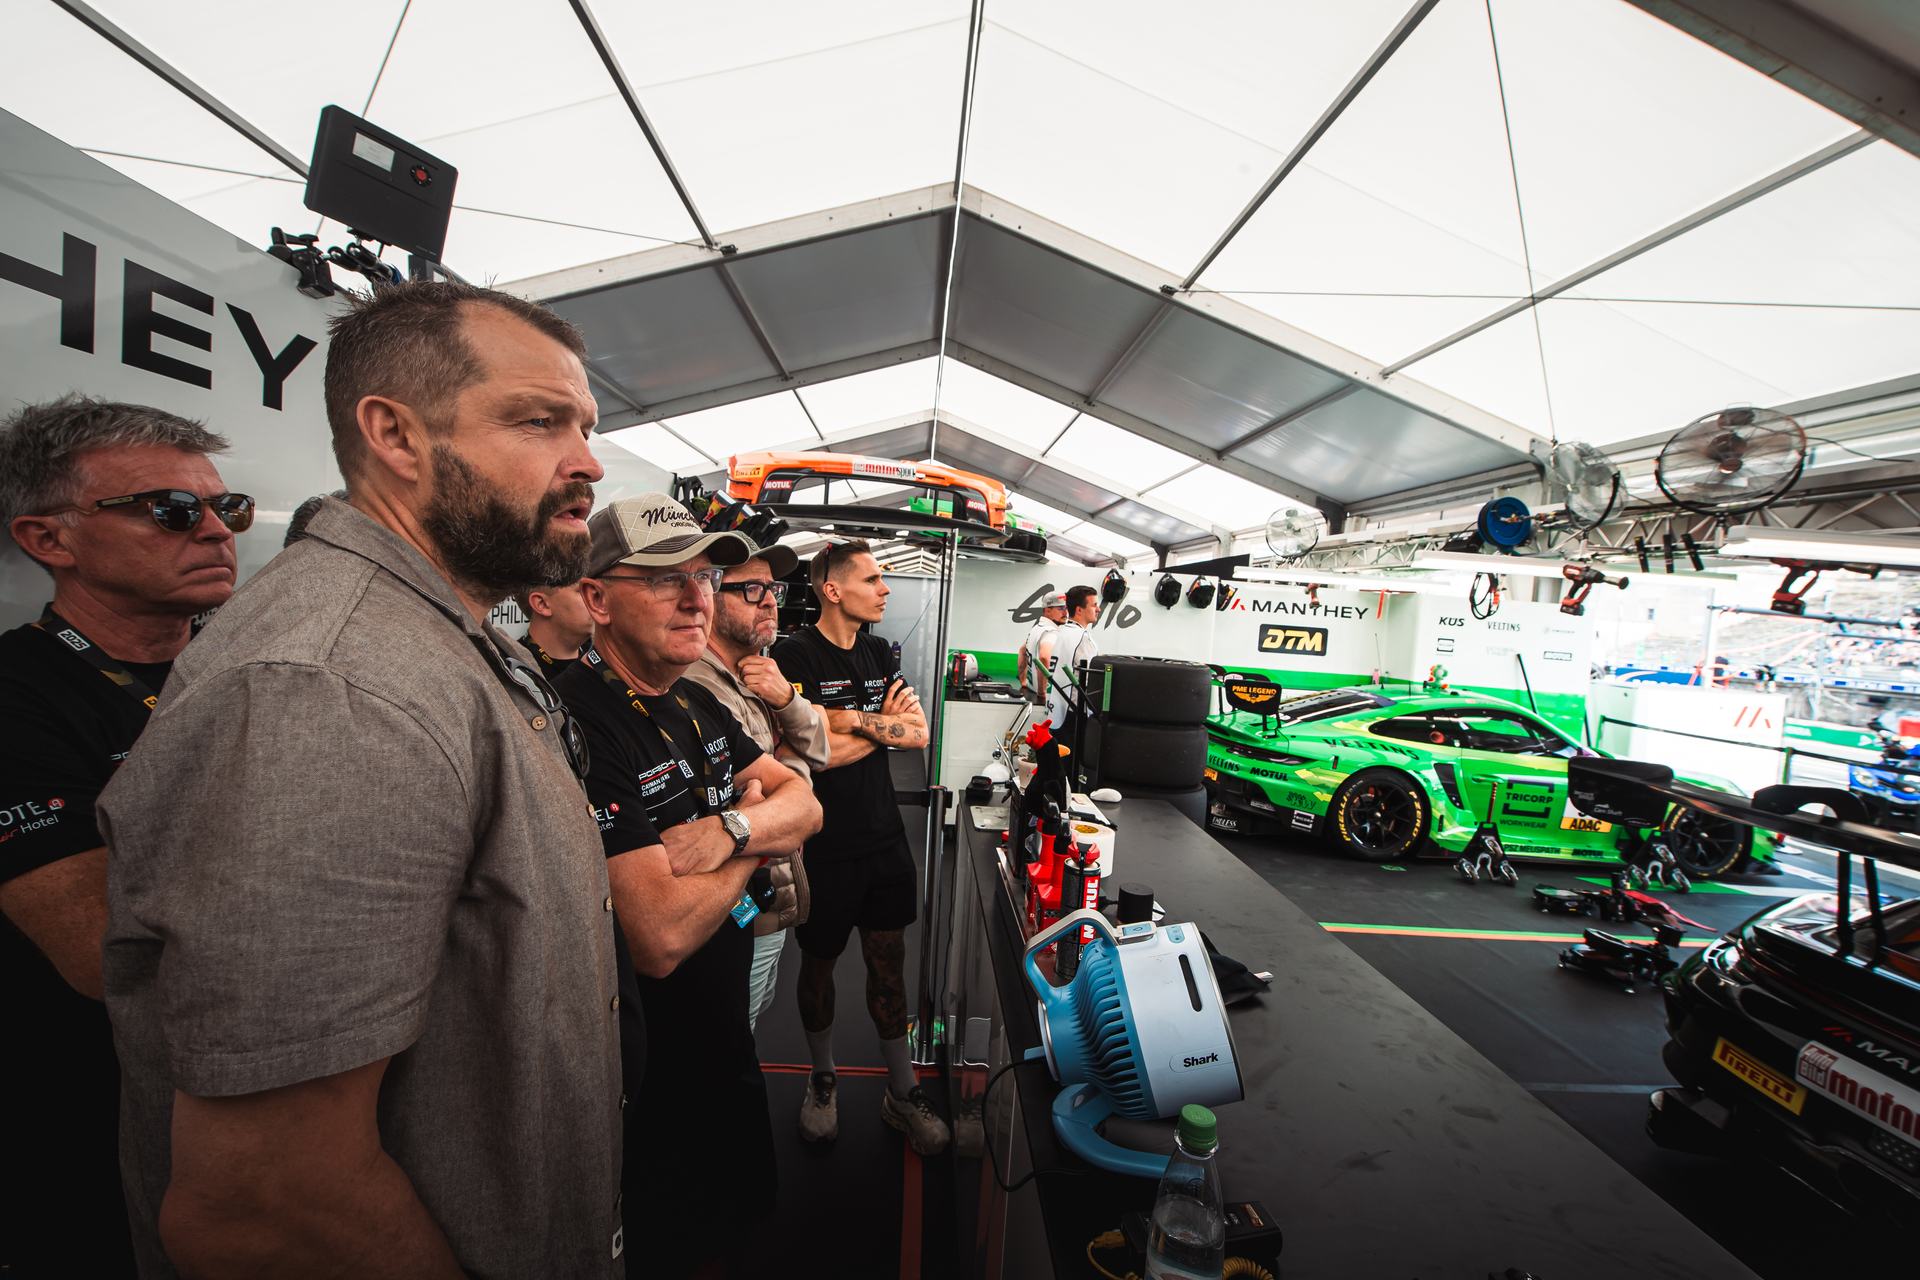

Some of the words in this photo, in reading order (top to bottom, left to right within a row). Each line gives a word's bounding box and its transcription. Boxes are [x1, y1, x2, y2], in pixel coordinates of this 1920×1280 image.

[764, 481, 791, 489] MOTUL
[1252, 600, 1368, 619] MANTHEY
[1487, 621, 1521, 632] VELTINS
[61, 630, 87, 650] 2025
[1262, 628, 1323, 652] DTM
[1231, 685, 1248, 693] PME
[1248, 686, 1277, 695] LEGEND
[1322, 738, 1420, 760] VELTINS
[1208, 754, 1240, 772] VELTINS
[1249, 767, 1289, 782] MOTUL
[708, 788, 717, 805] 2025
[1506, 792, 1554, 804] TRICORP
[20, 814, 59, 833] Hotel
[1338, 794, 1352, 842] PIRELLI
[1500, 819, 1548, 829] WORKWEAR
[1570, 818, 1602, 832] ADAC
[1082, 879, 1099, 939] MTUL
[1183, 1052, 1218, 1067] Shark
[1803, 1045, 1834, 1069] Auto
[1720, 1042, 1799, 1104] PIRELLI
[1799, 1060, 1825, 1087] Bild
